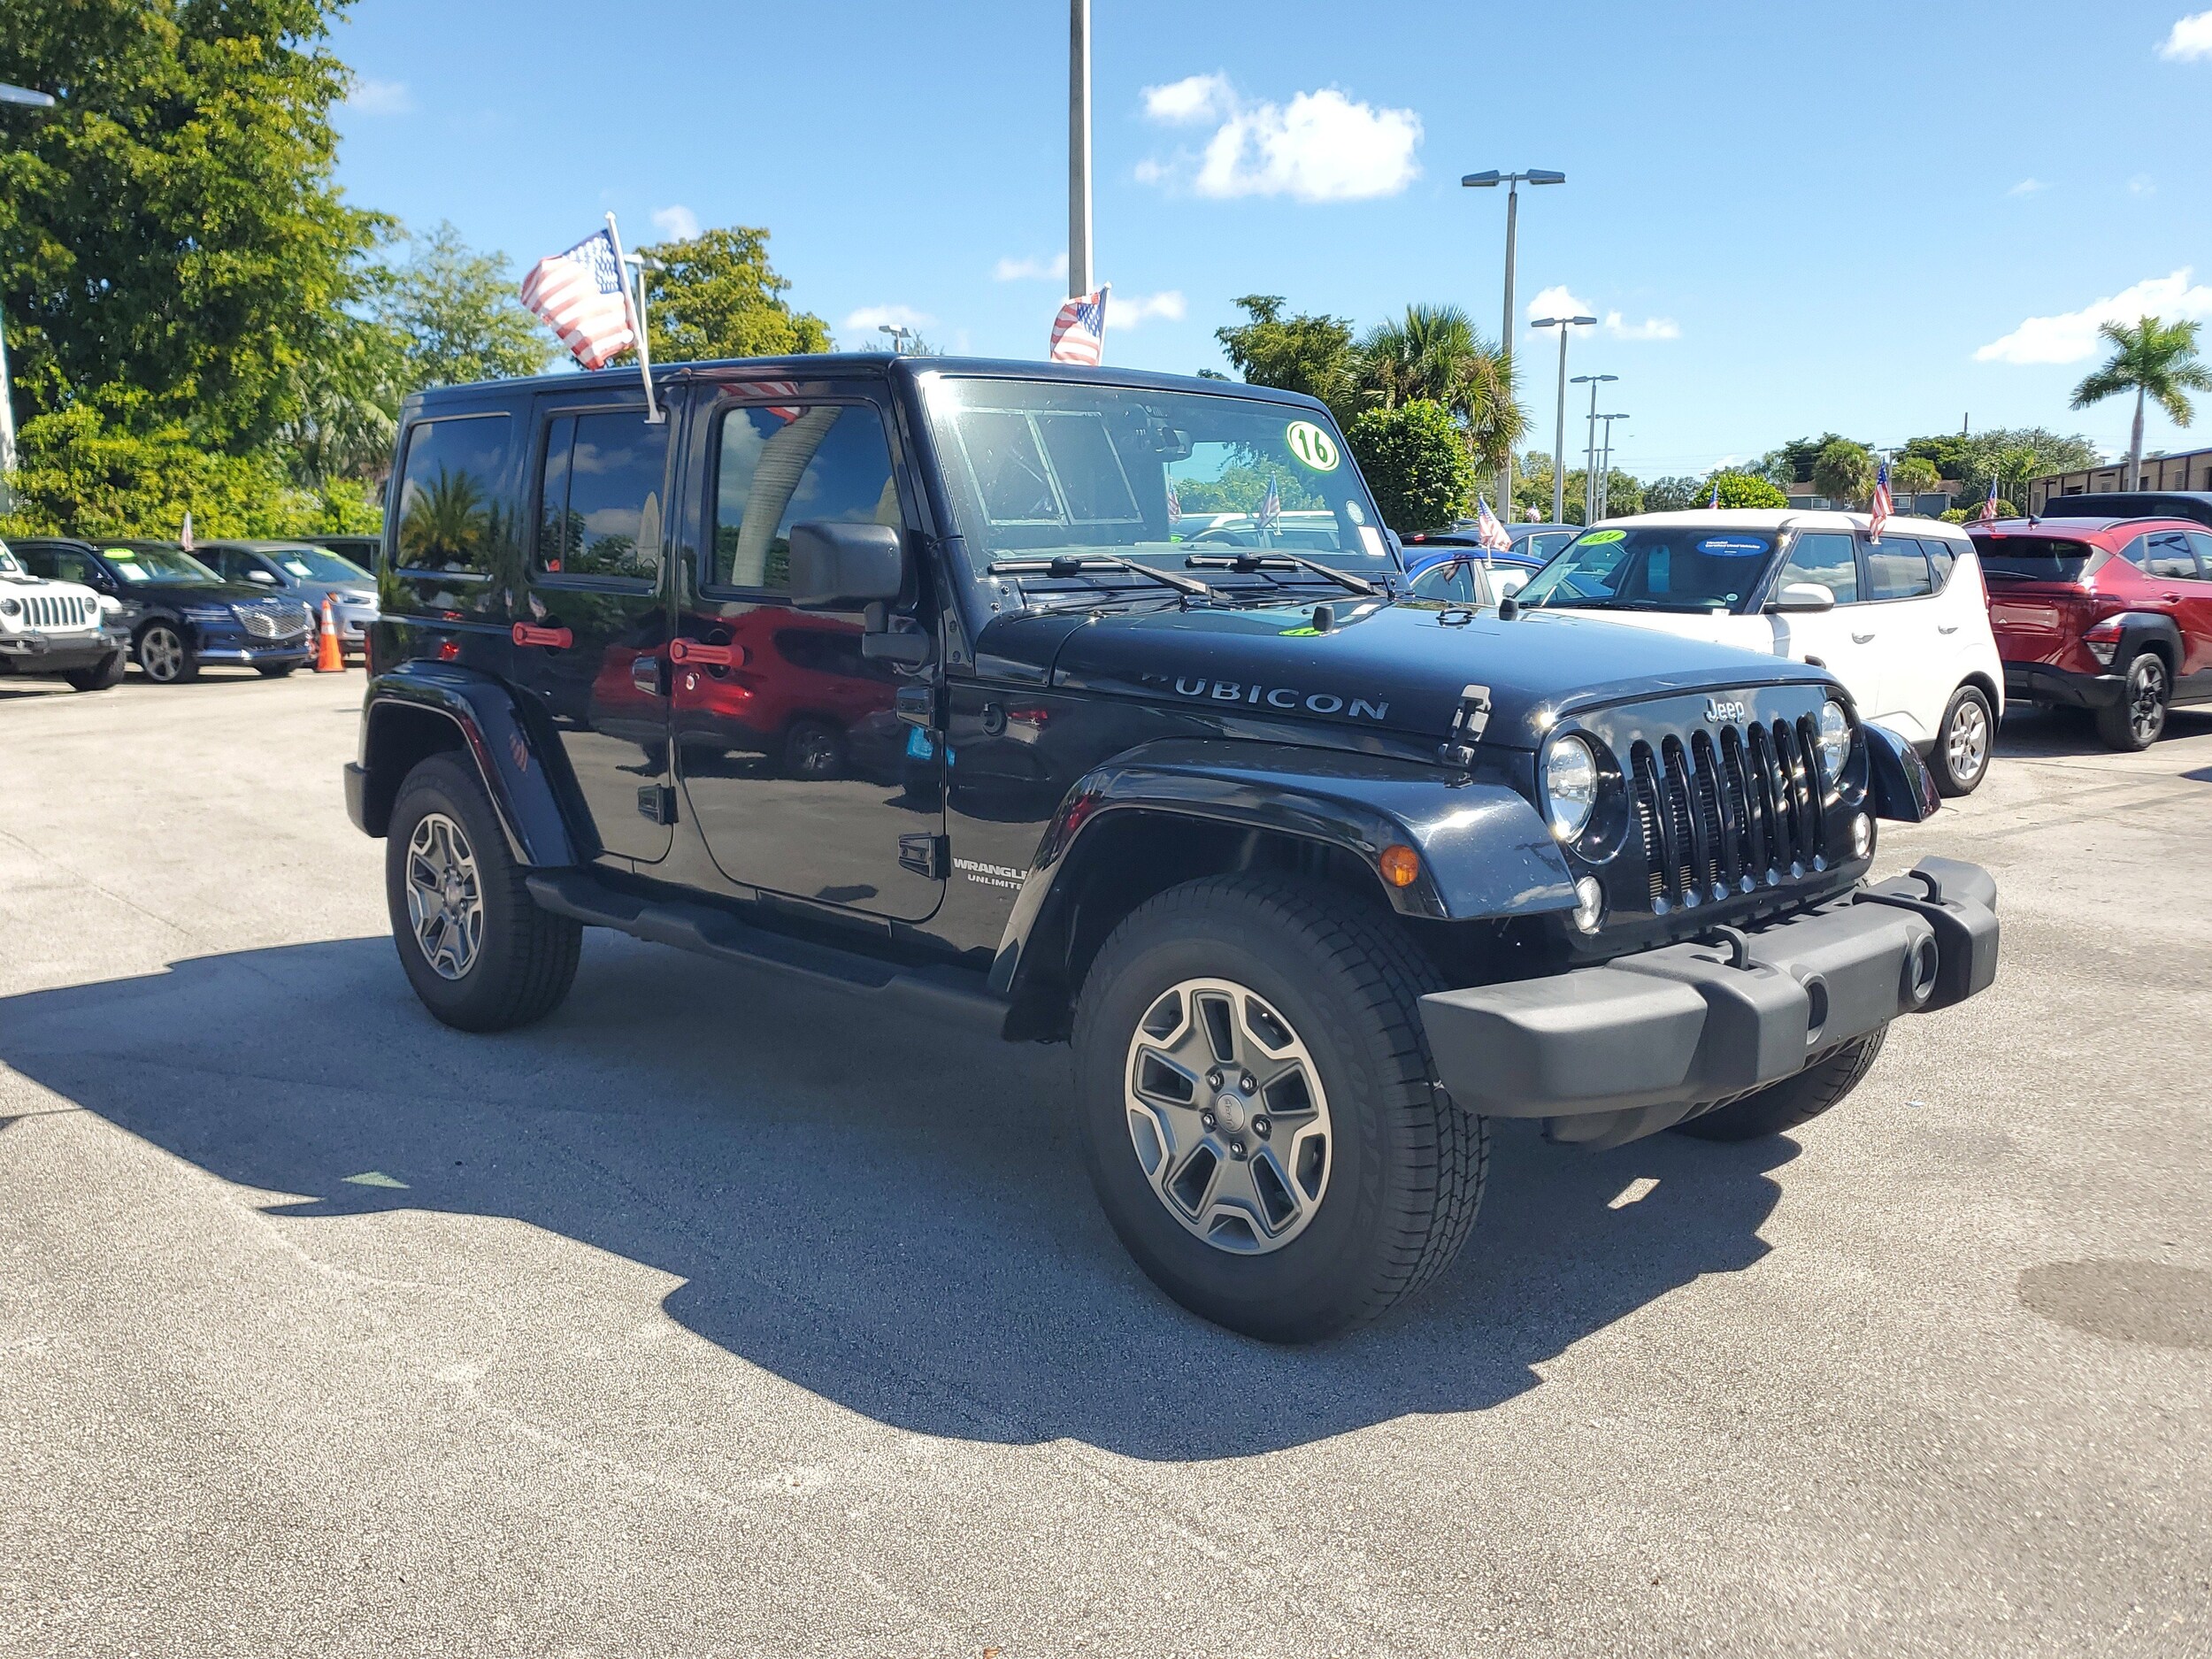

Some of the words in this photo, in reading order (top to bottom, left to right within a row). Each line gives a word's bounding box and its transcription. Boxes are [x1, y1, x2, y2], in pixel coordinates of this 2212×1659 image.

[1298, 428, 1327, 464] 16
[1704, 697, 1745, 724] Jeep
[953, 857, 1027, 880] WRANGLE
[967, 873, 1023, 890] UNLIMITE
